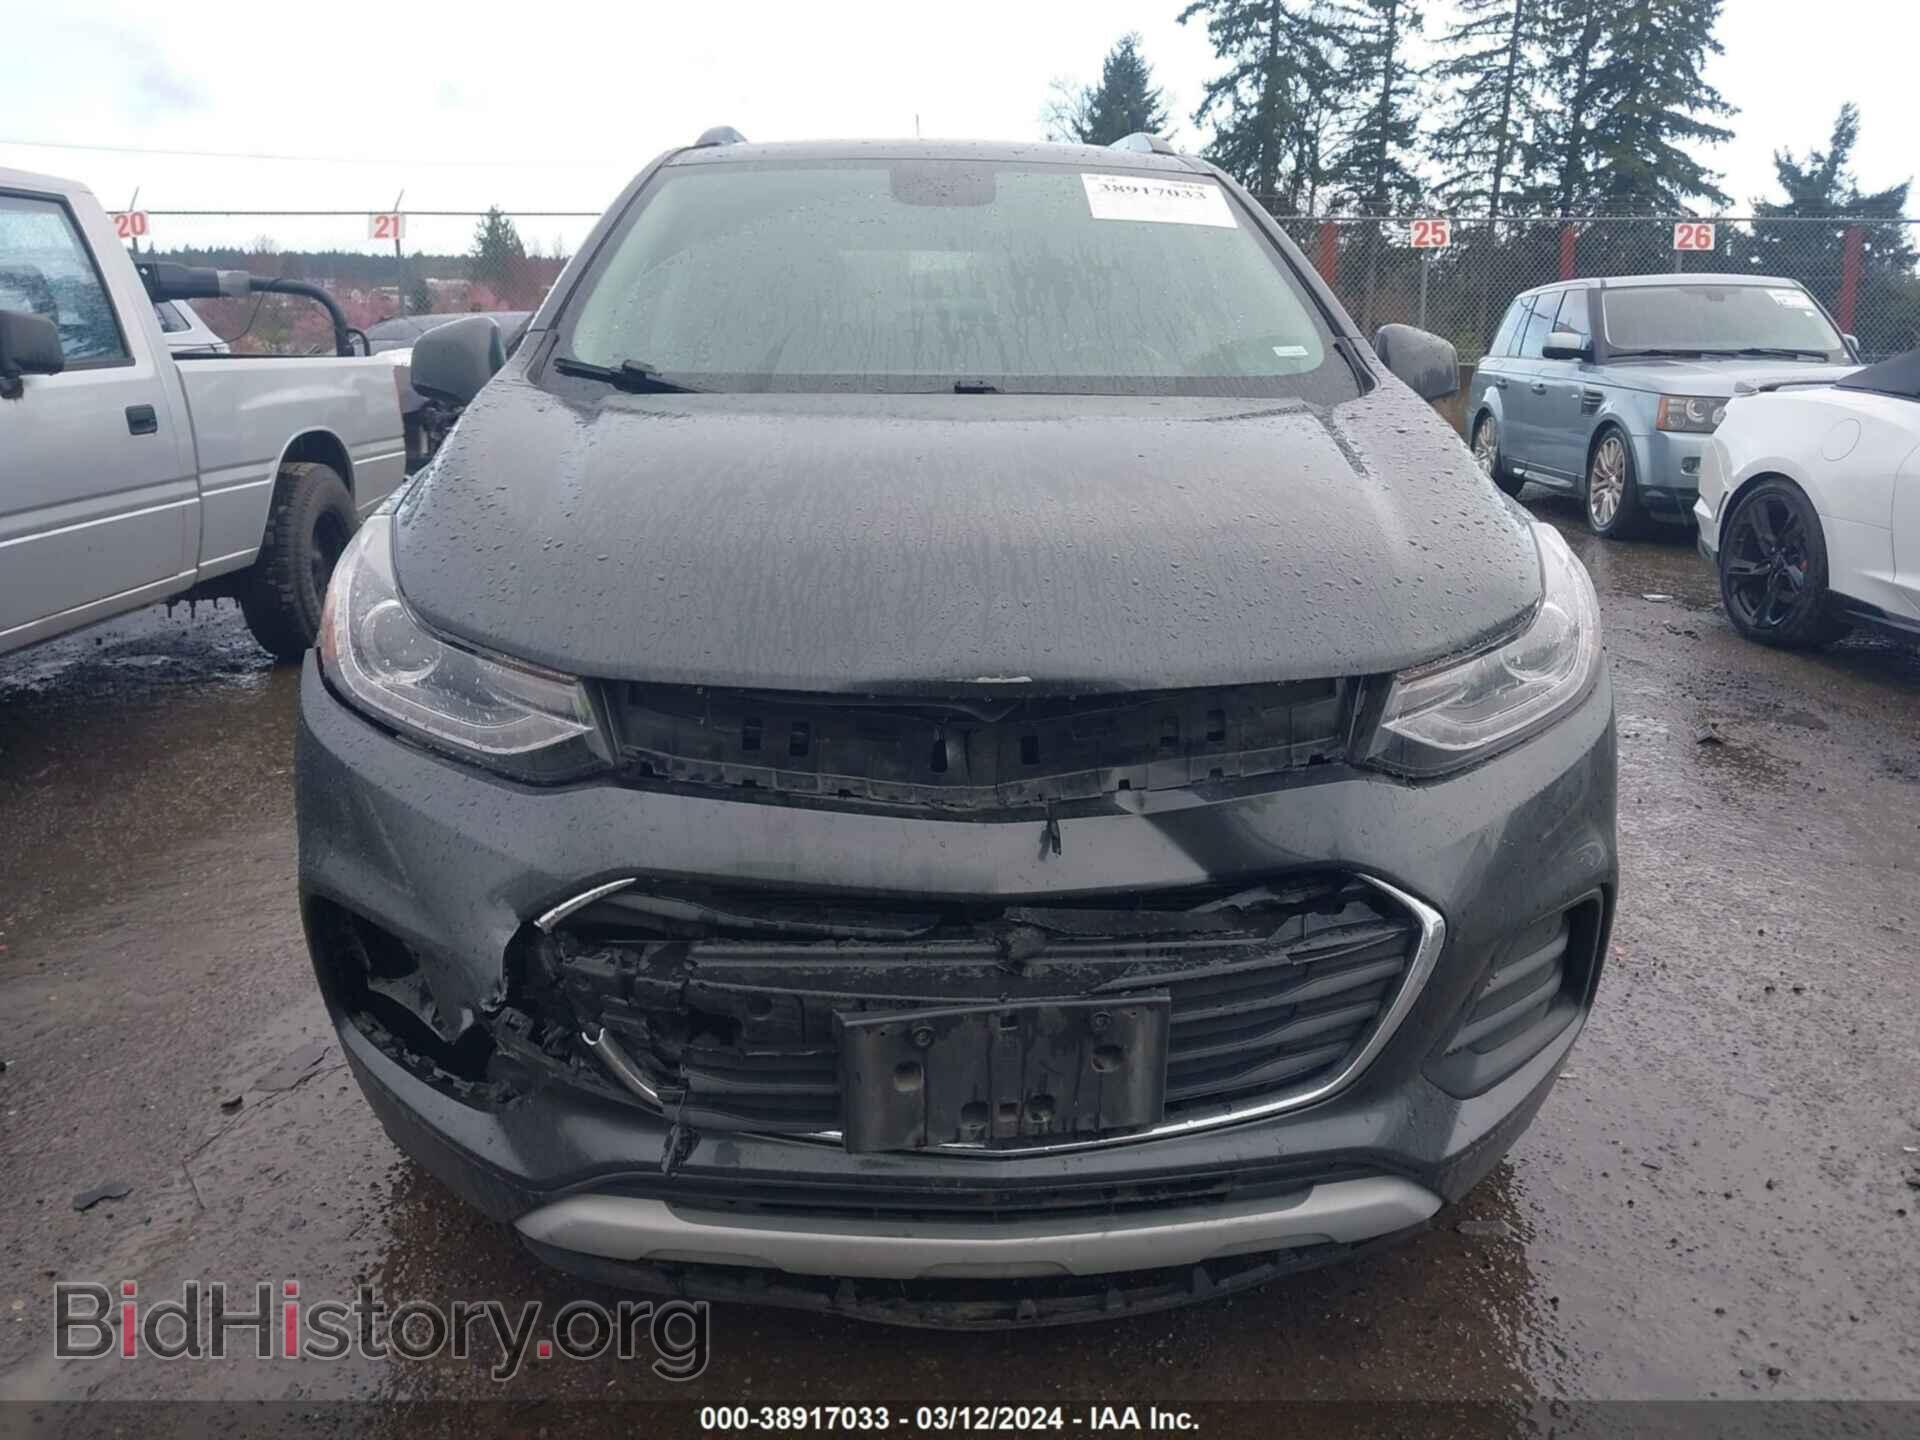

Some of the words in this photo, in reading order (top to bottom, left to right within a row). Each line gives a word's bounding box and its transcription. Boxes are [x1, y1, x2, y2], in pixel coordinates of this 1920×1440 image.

[114, 212, 146, 238] 20
[374, 215, 400, 238] 21
[1414, 221, 1447, 246] 25
[1678, 224, 1711, 249] 26
